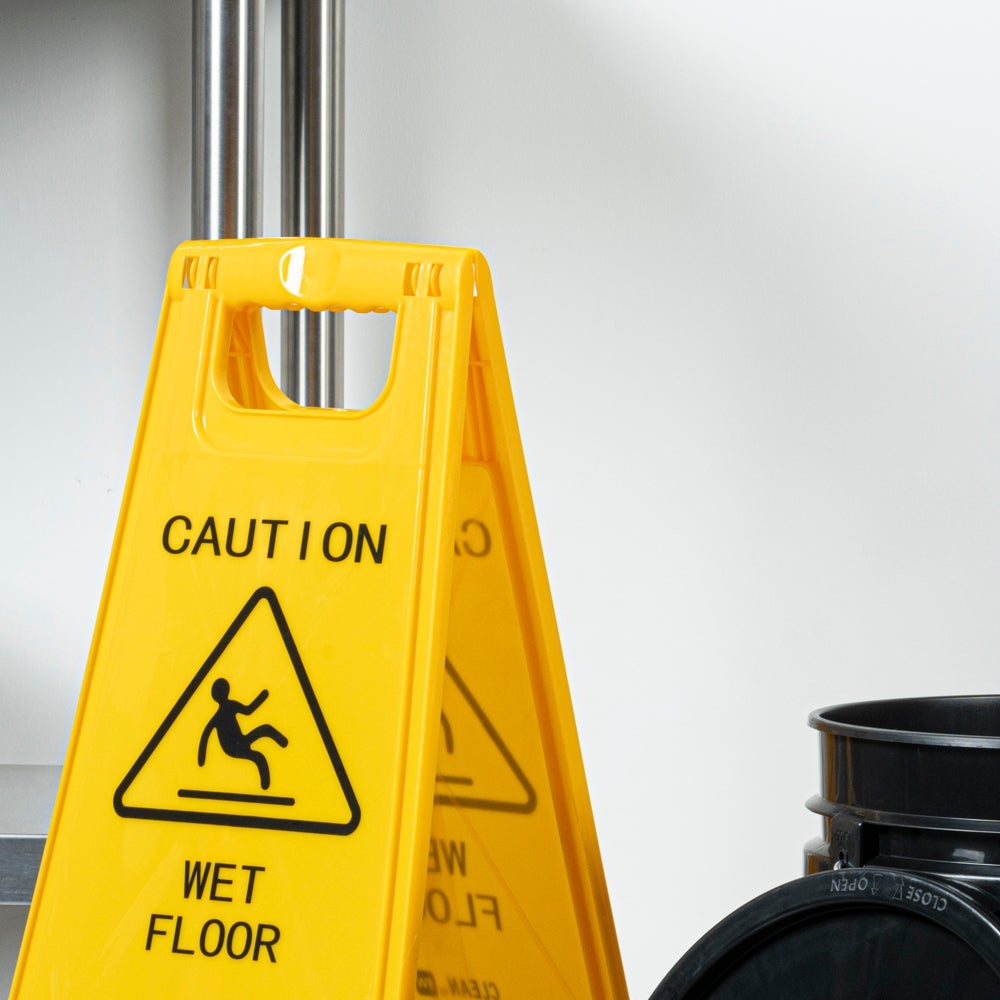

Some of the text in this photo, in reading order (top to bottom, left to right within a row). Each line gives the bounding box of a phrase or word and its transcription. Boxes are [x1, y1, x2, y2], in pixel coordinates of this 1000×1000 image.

[162, 515, 387, 564] CAUTION
[183, 860, 266, 904] WET
[830, 877, 869, 892] OPEN
[905, 885, 949, 912] CLOSE
[145, 913, 281, 963] FLOOR
